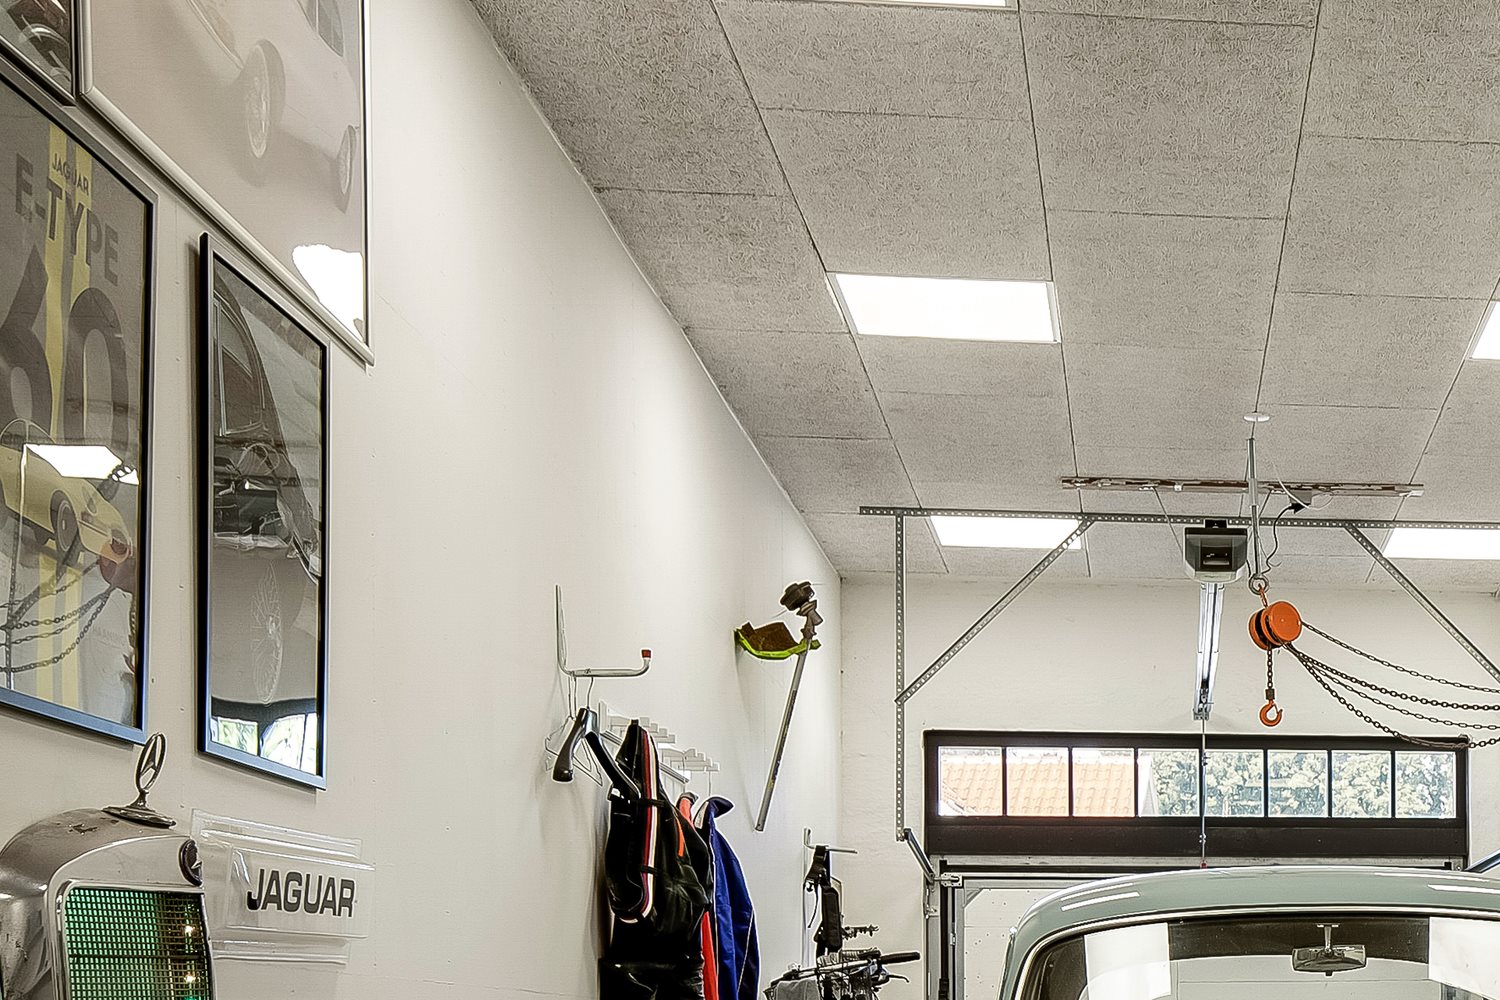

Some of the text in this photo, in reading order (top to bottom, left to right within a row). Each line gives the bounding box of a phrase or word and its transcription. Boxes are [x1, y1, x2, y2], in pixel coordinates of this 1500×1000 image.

[52, 152, 89, 196] JAGUAR
[15, 152, 119, 287] E-TYPE
[246, 867, 355, 918] JAGUAR
